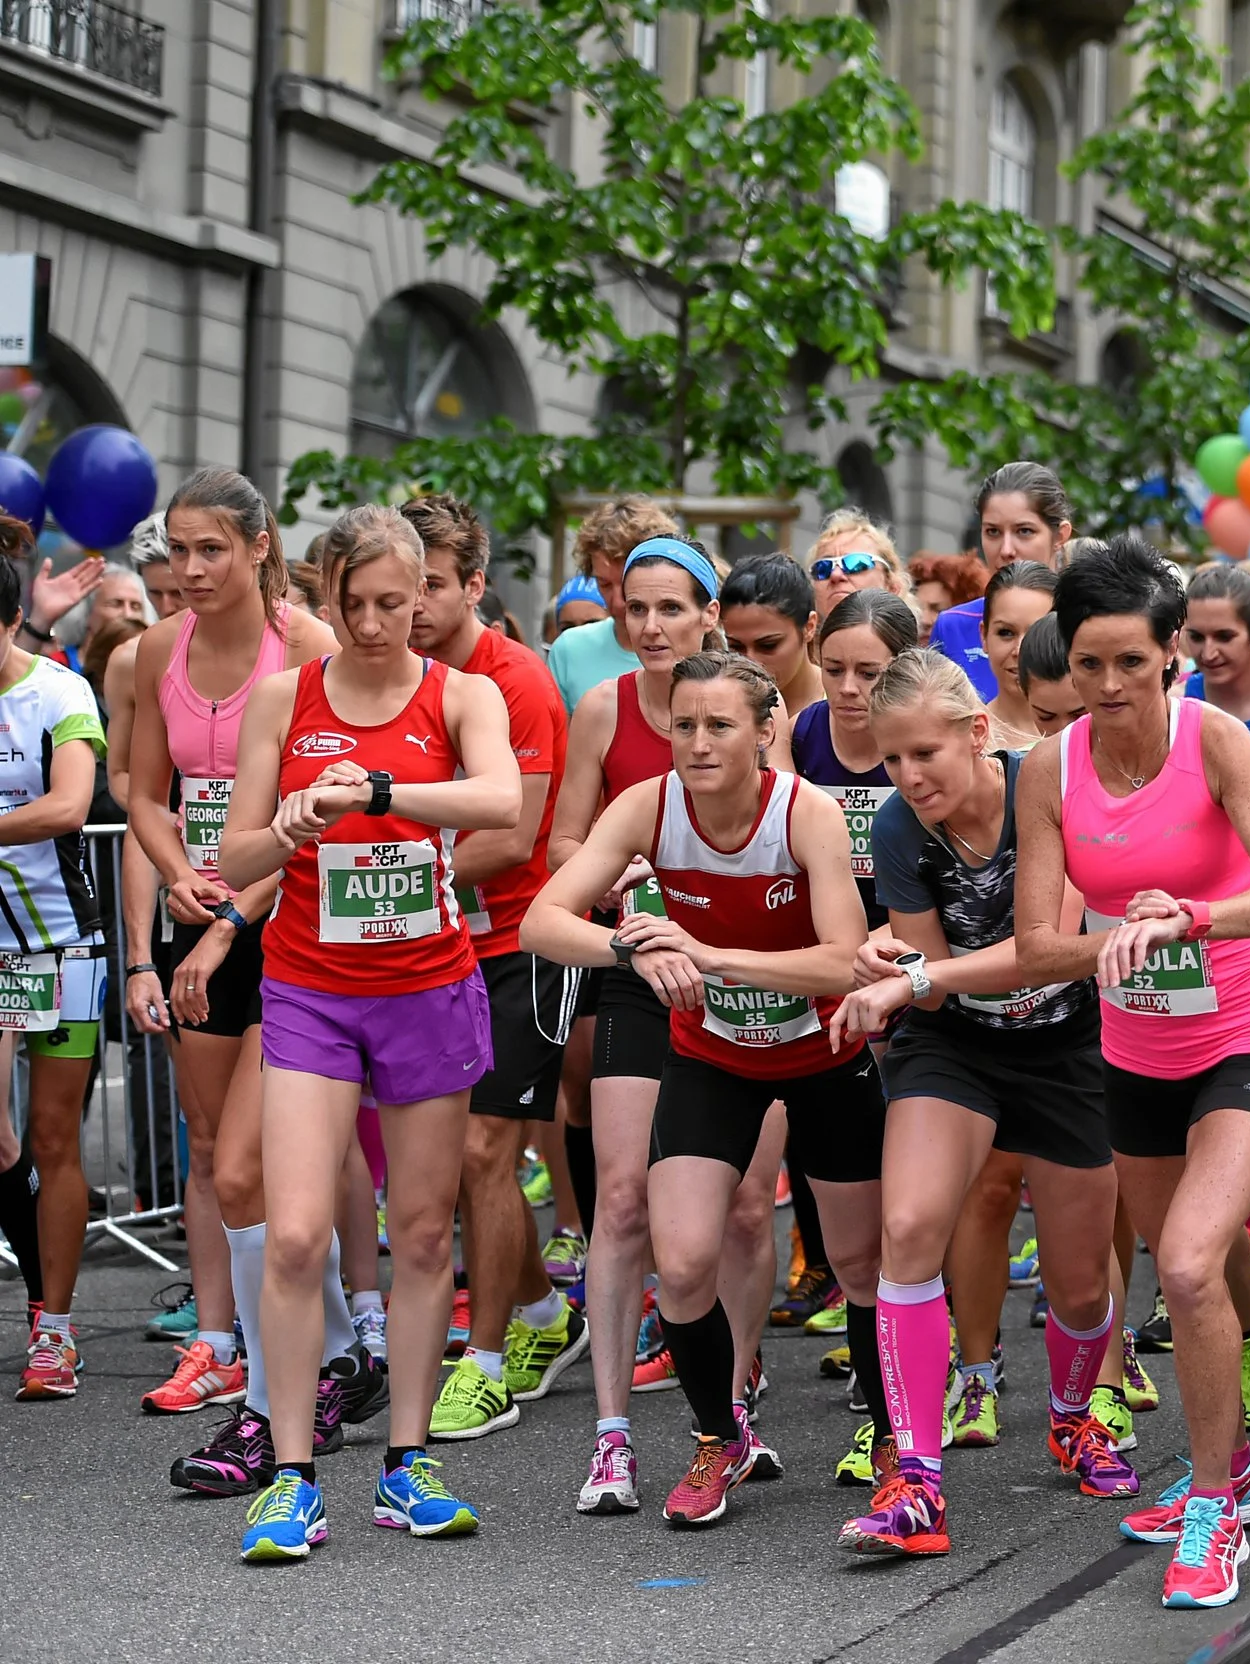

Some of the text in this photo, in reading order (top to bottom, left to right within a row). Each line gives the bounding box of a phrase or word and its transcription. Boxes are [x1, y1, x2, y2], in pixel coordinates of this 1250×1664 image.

[209, 781, 227, 790] KPT
[845, 789, 870, 799] KPT
[852, 799, 877, 809] CPT
[371, 844, 400, 856] KPT
[380, 854, 407, 867] CPT
[344, 870, 425, 900] AUDE
[664, 885, 704, 905] VAUCHER
[373, 901, 396, 916] 53
[3, 953, 26, 963] KPT
[1131, 946, 1199, 972] ULA
[9, 962, 31, 972] CPT
[1134, 974, 1155, 990] 52
[745, 1012, 767, 1026] 55
